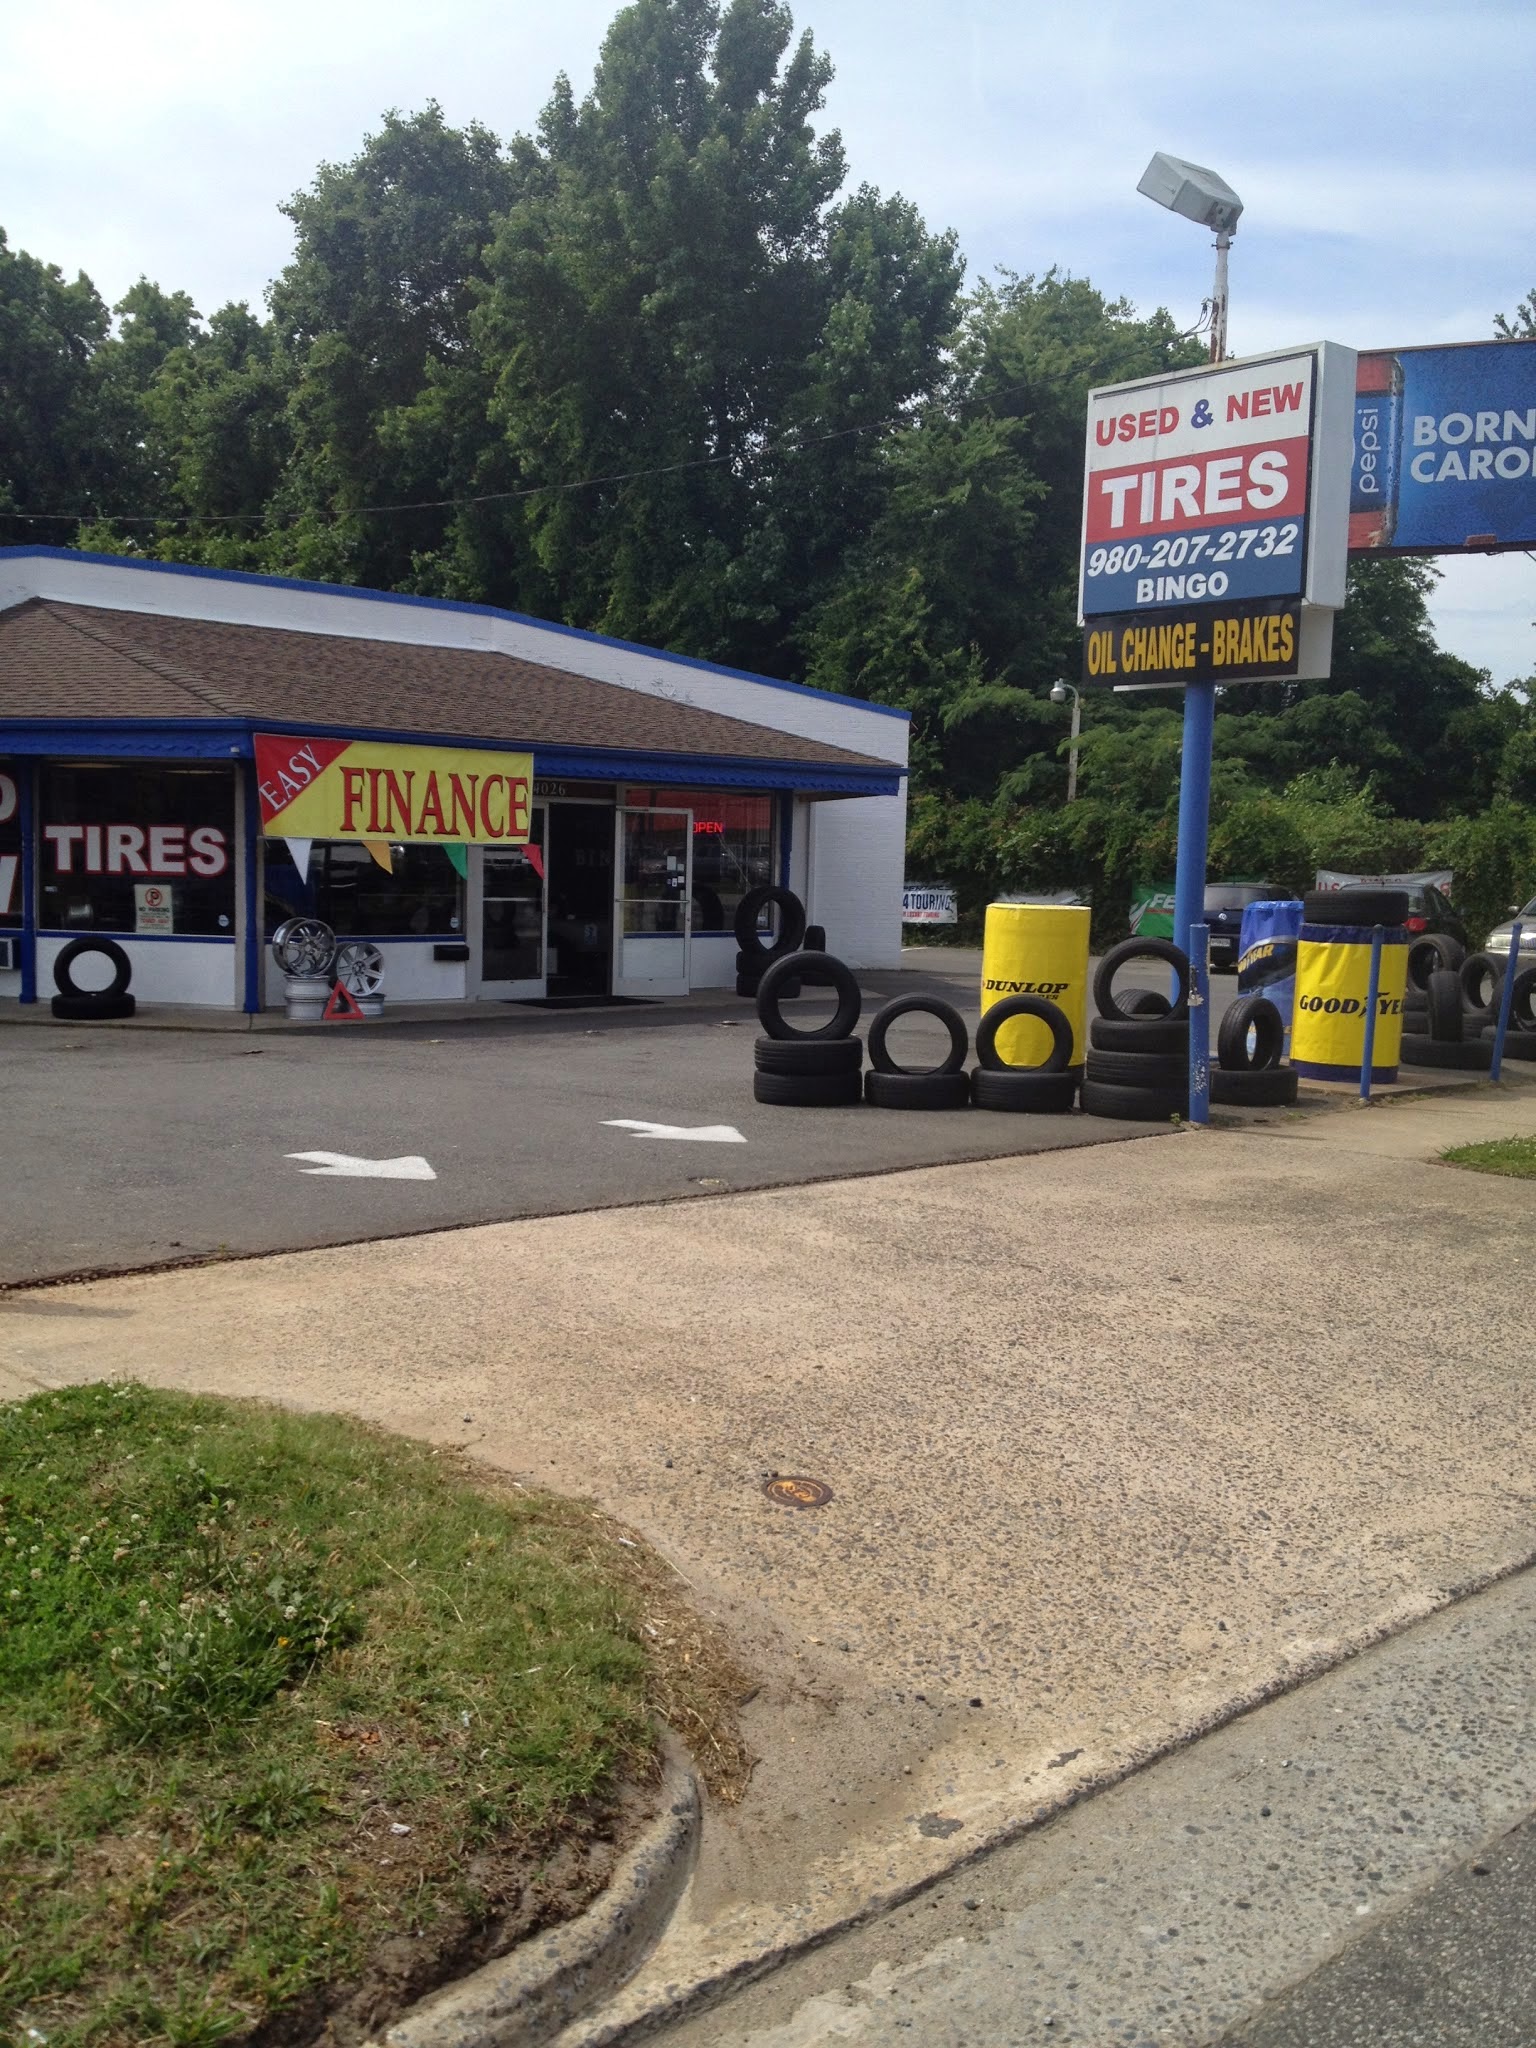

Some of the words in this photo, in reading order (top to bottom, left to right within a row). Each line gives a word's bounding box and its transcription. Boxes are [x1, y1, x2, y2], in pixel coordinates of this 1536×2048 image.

[1095, 406, 1180, 447] USED
[1190, 398, 1214, 429] &
[1226, 381, 1304, 422] NEW
[1412, 409, 1536, 446] BORN
[1357, 408, 1382, 493] pepsi
[1410, 446, 1536, 484] CARO
[1101, 450, 1289, 529] TIRES
[1087, 523, 1299, 577] 980-207-2732
[1136, 570, 1229, 604] BINGO
[1087, 630, 1117, 676] OIL
[258, 743, 323, 812] EASY
[339, 765, 529, 838] FINANCE
[44, 824, 227, 877] TIRES
[693, 821, 724, 834] OPEN
[911, 893, 952, 911] TOURING
[1149, 893, 1176, 909] FE
[986, 979, 1070, 994] DUNLOP
